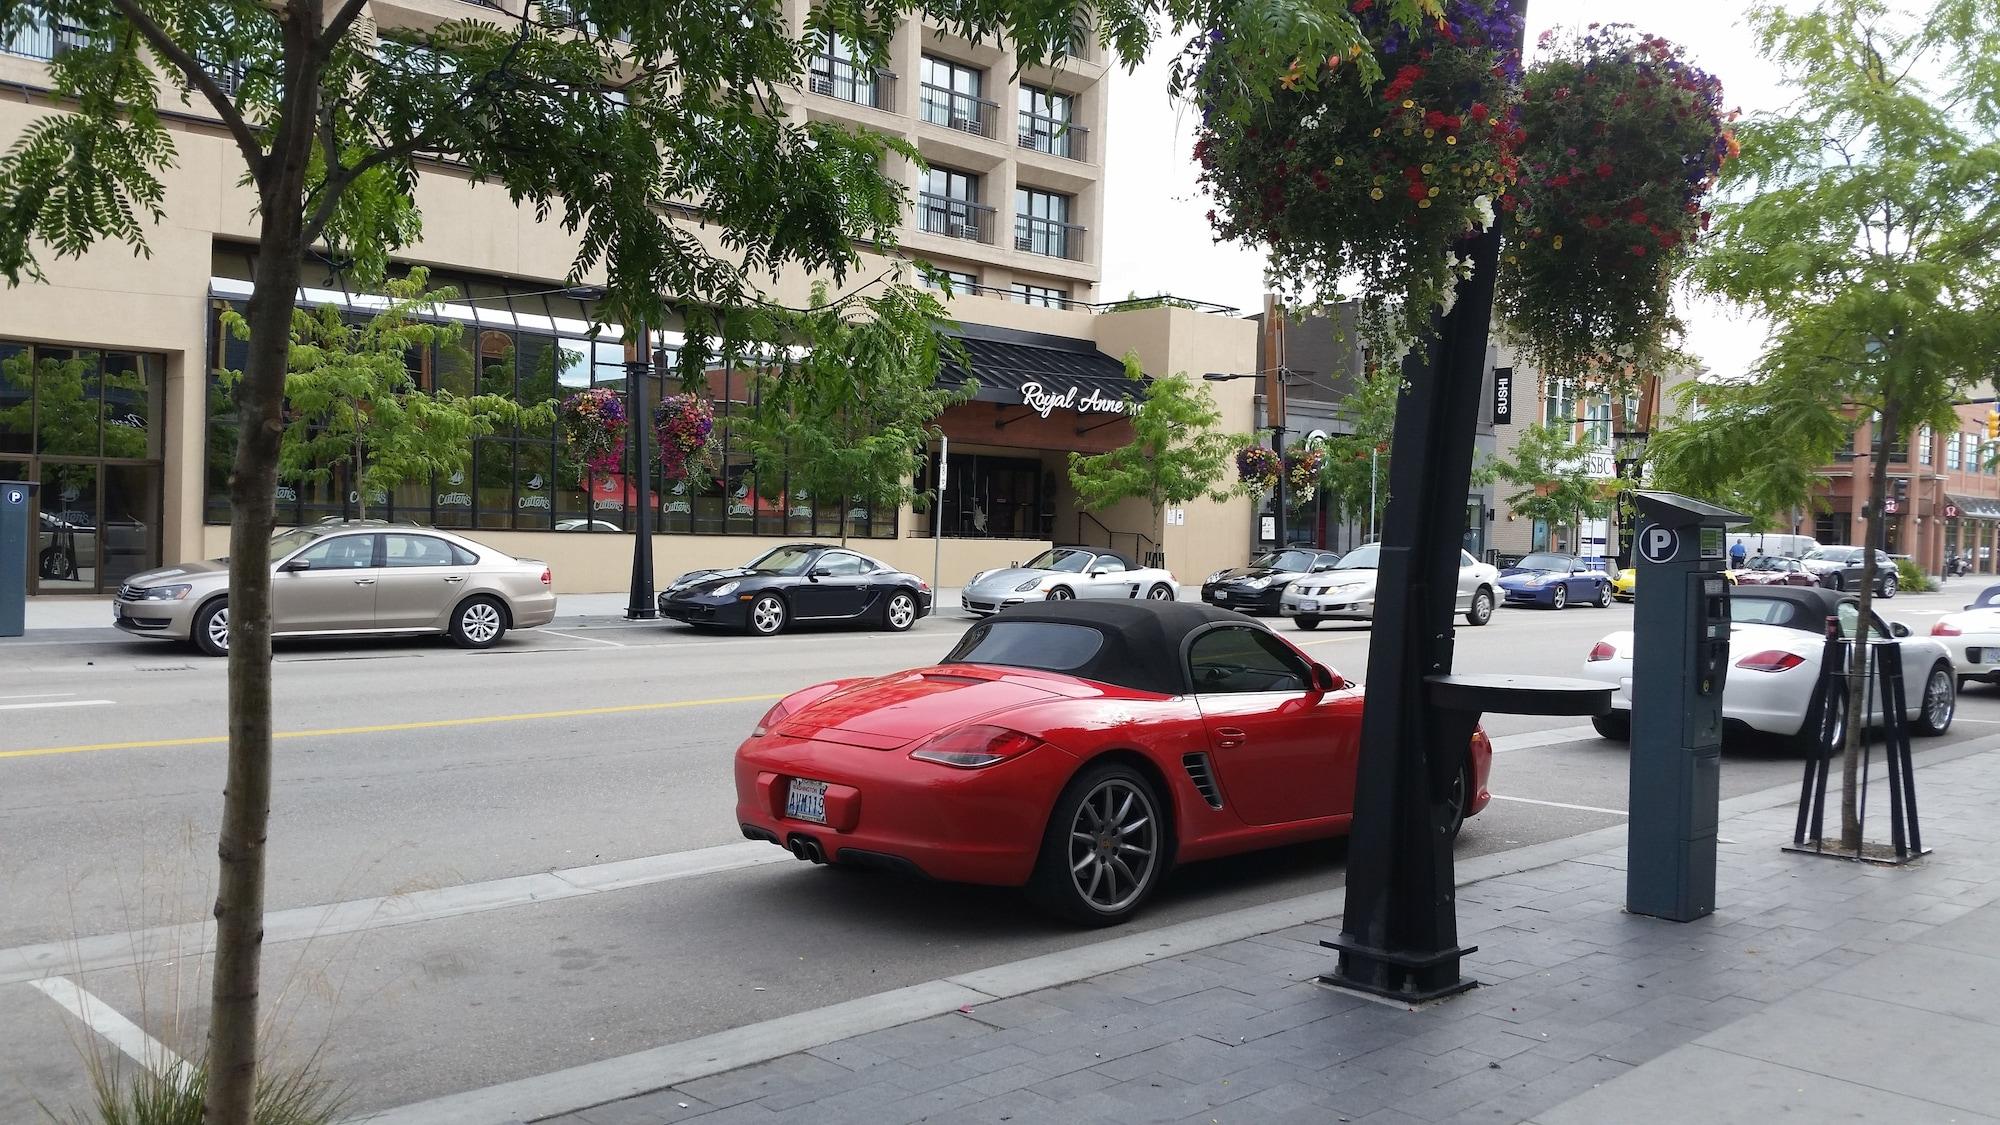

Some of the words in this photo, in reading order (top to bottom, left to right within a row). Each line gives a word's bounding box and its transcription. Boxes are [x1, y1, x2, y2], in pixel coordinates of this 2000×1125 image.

[1021, 382, 1078, 418] Royal
[1078, 389, 1125, 413] Anne
[1497, 378, 1509, 415] SUSHI
[1650, 529, 1671, 558] P
[789, 791, 824, 815] AVM119
